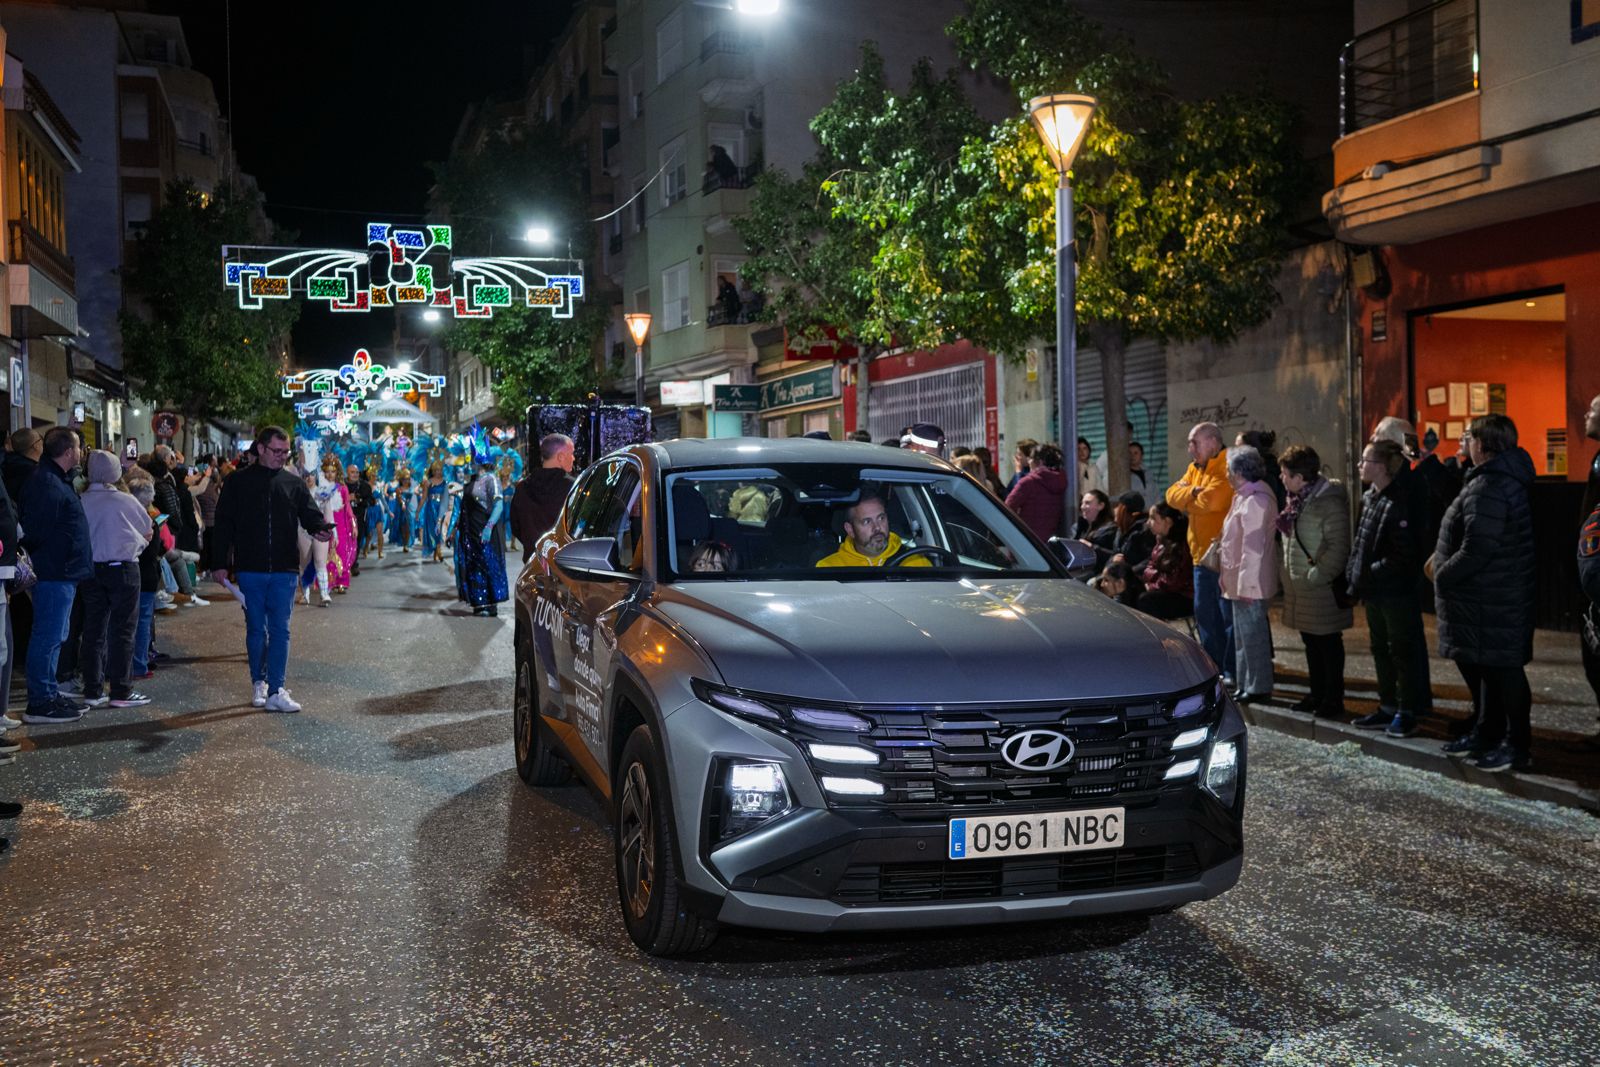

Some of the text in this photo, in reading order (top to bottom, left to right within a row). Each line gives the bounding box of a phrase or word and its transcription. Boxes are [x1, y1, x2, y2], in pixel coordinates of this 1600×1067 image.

[534, 595, 564, 640] TUCSON
[576, 626, 590, 653] Llega
[574, 653, 589, 680] donde
[954, 842, 962, 852] E
[973, 814, 1118, 853] 0961 NBC
